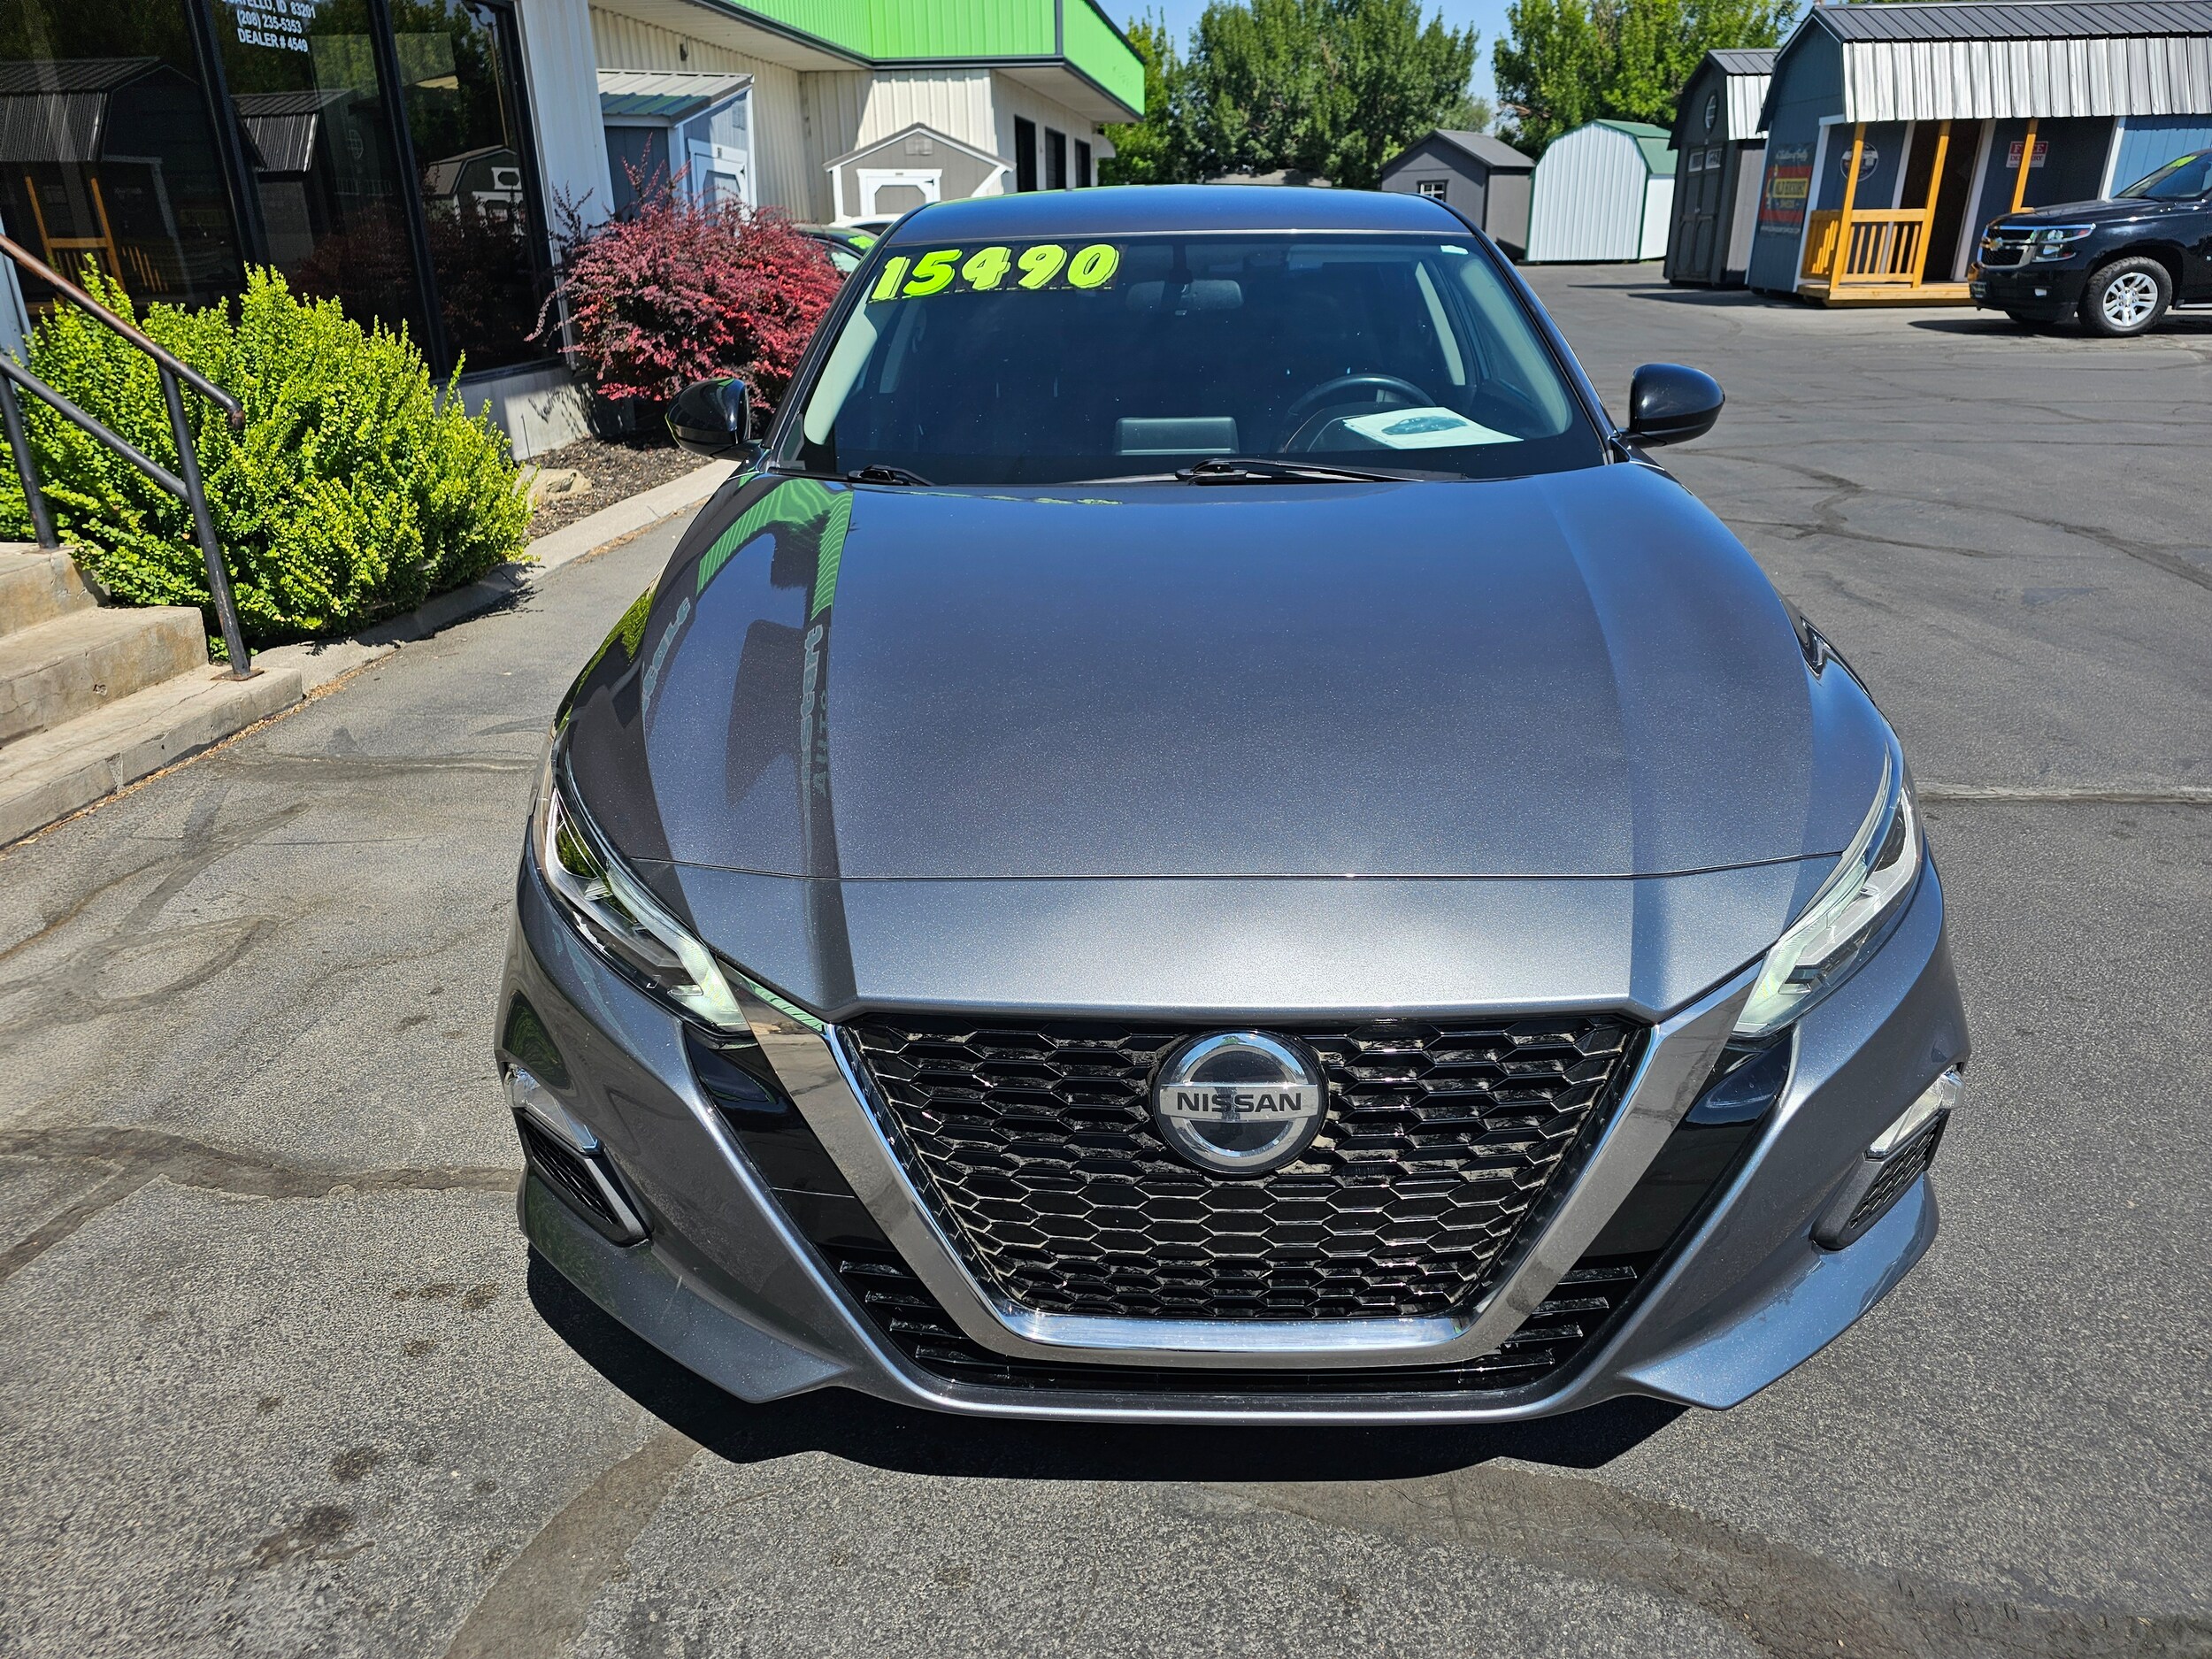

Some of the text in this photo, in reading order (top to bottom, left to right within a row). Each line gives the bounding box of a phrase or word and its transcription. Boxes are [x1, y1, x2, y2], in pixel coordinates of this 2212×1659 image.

[237, 9, 303, 35] (208) 235-5353
[289, 1, 317, 19] 83201
[237, 27, 309, 53] DEALER # 4549
[872, 244, 1120, 299] 15490
[1177, 1092, 1302, 1113] NISSAN
